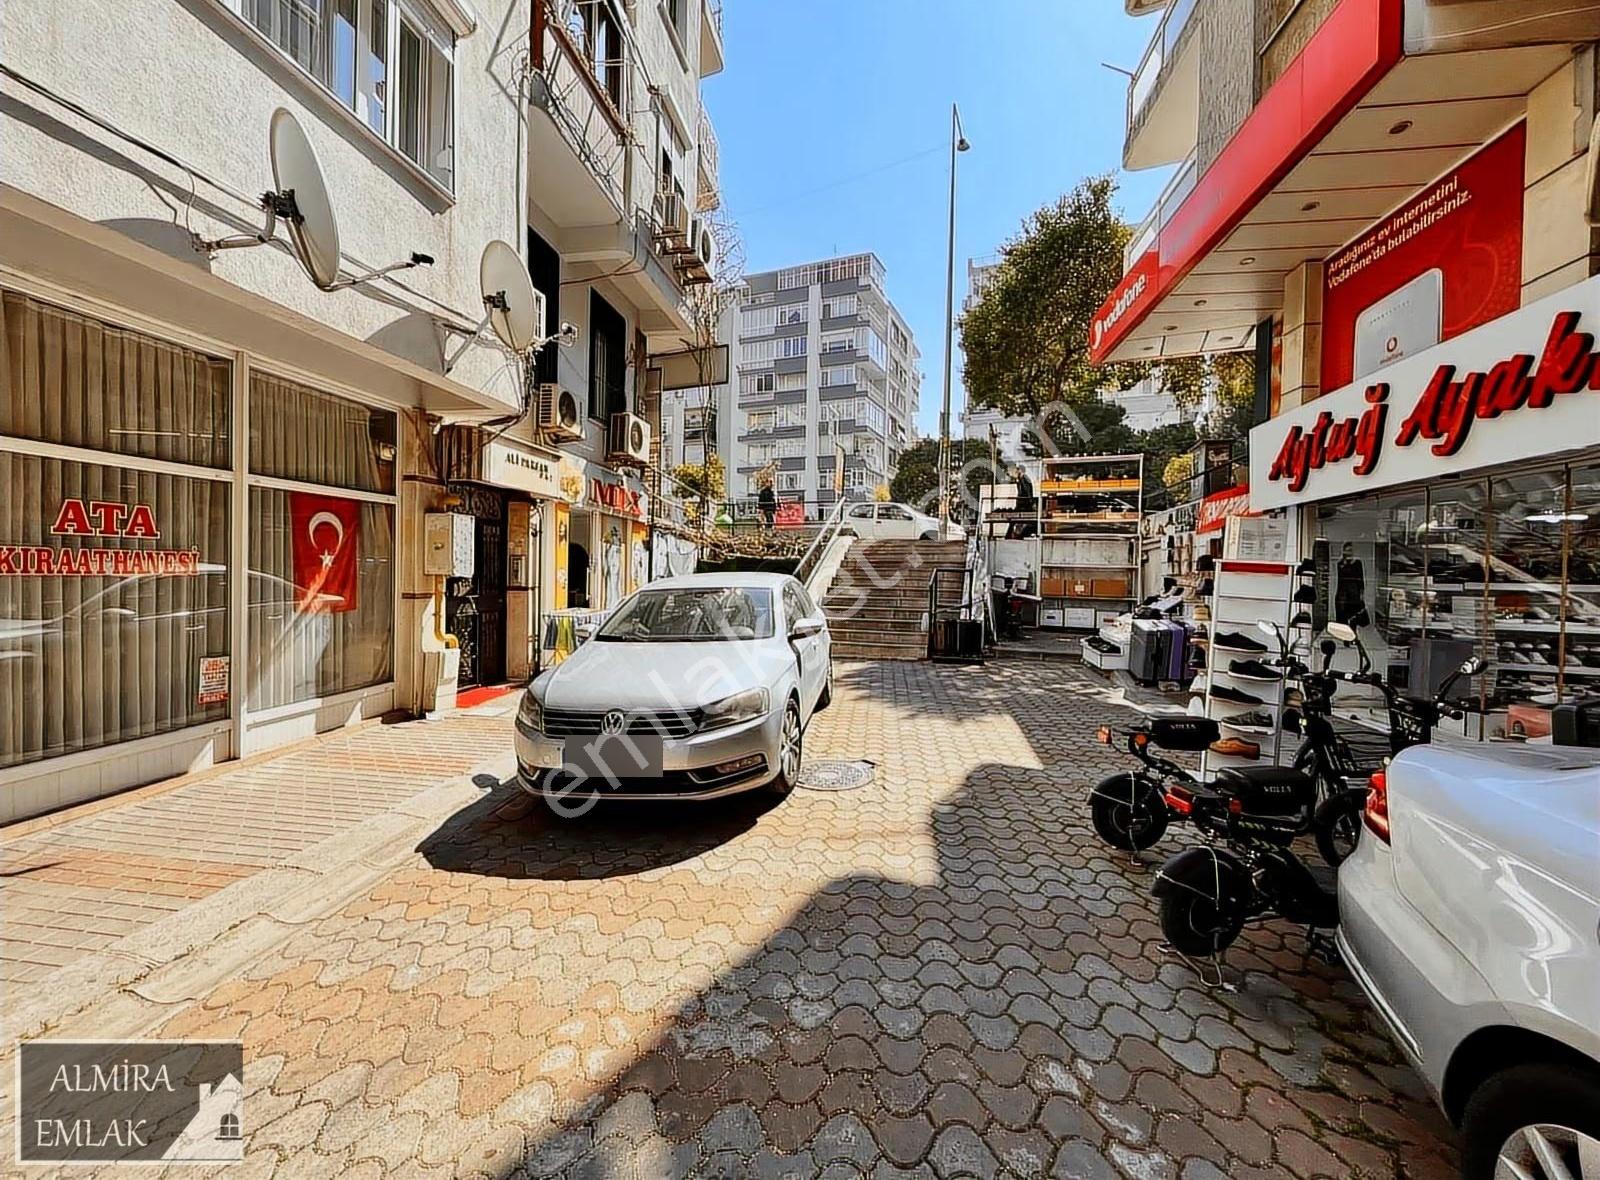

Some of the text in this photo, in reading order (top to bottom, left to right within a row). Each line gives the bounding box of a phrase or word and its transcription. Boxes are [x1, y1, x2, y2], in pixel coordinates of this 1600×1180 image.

[1378, 224, 1391, 240] ev
[1393, 175, 1458, 231] internetini
[1388, 190, 1473, 251] bulabilirsiniz.
[1103, 273, 1146, 333] vodafone
[1268, 311, 1600, 492] Aytuğ Ayak
[51, 498, 160, 539] ATA
